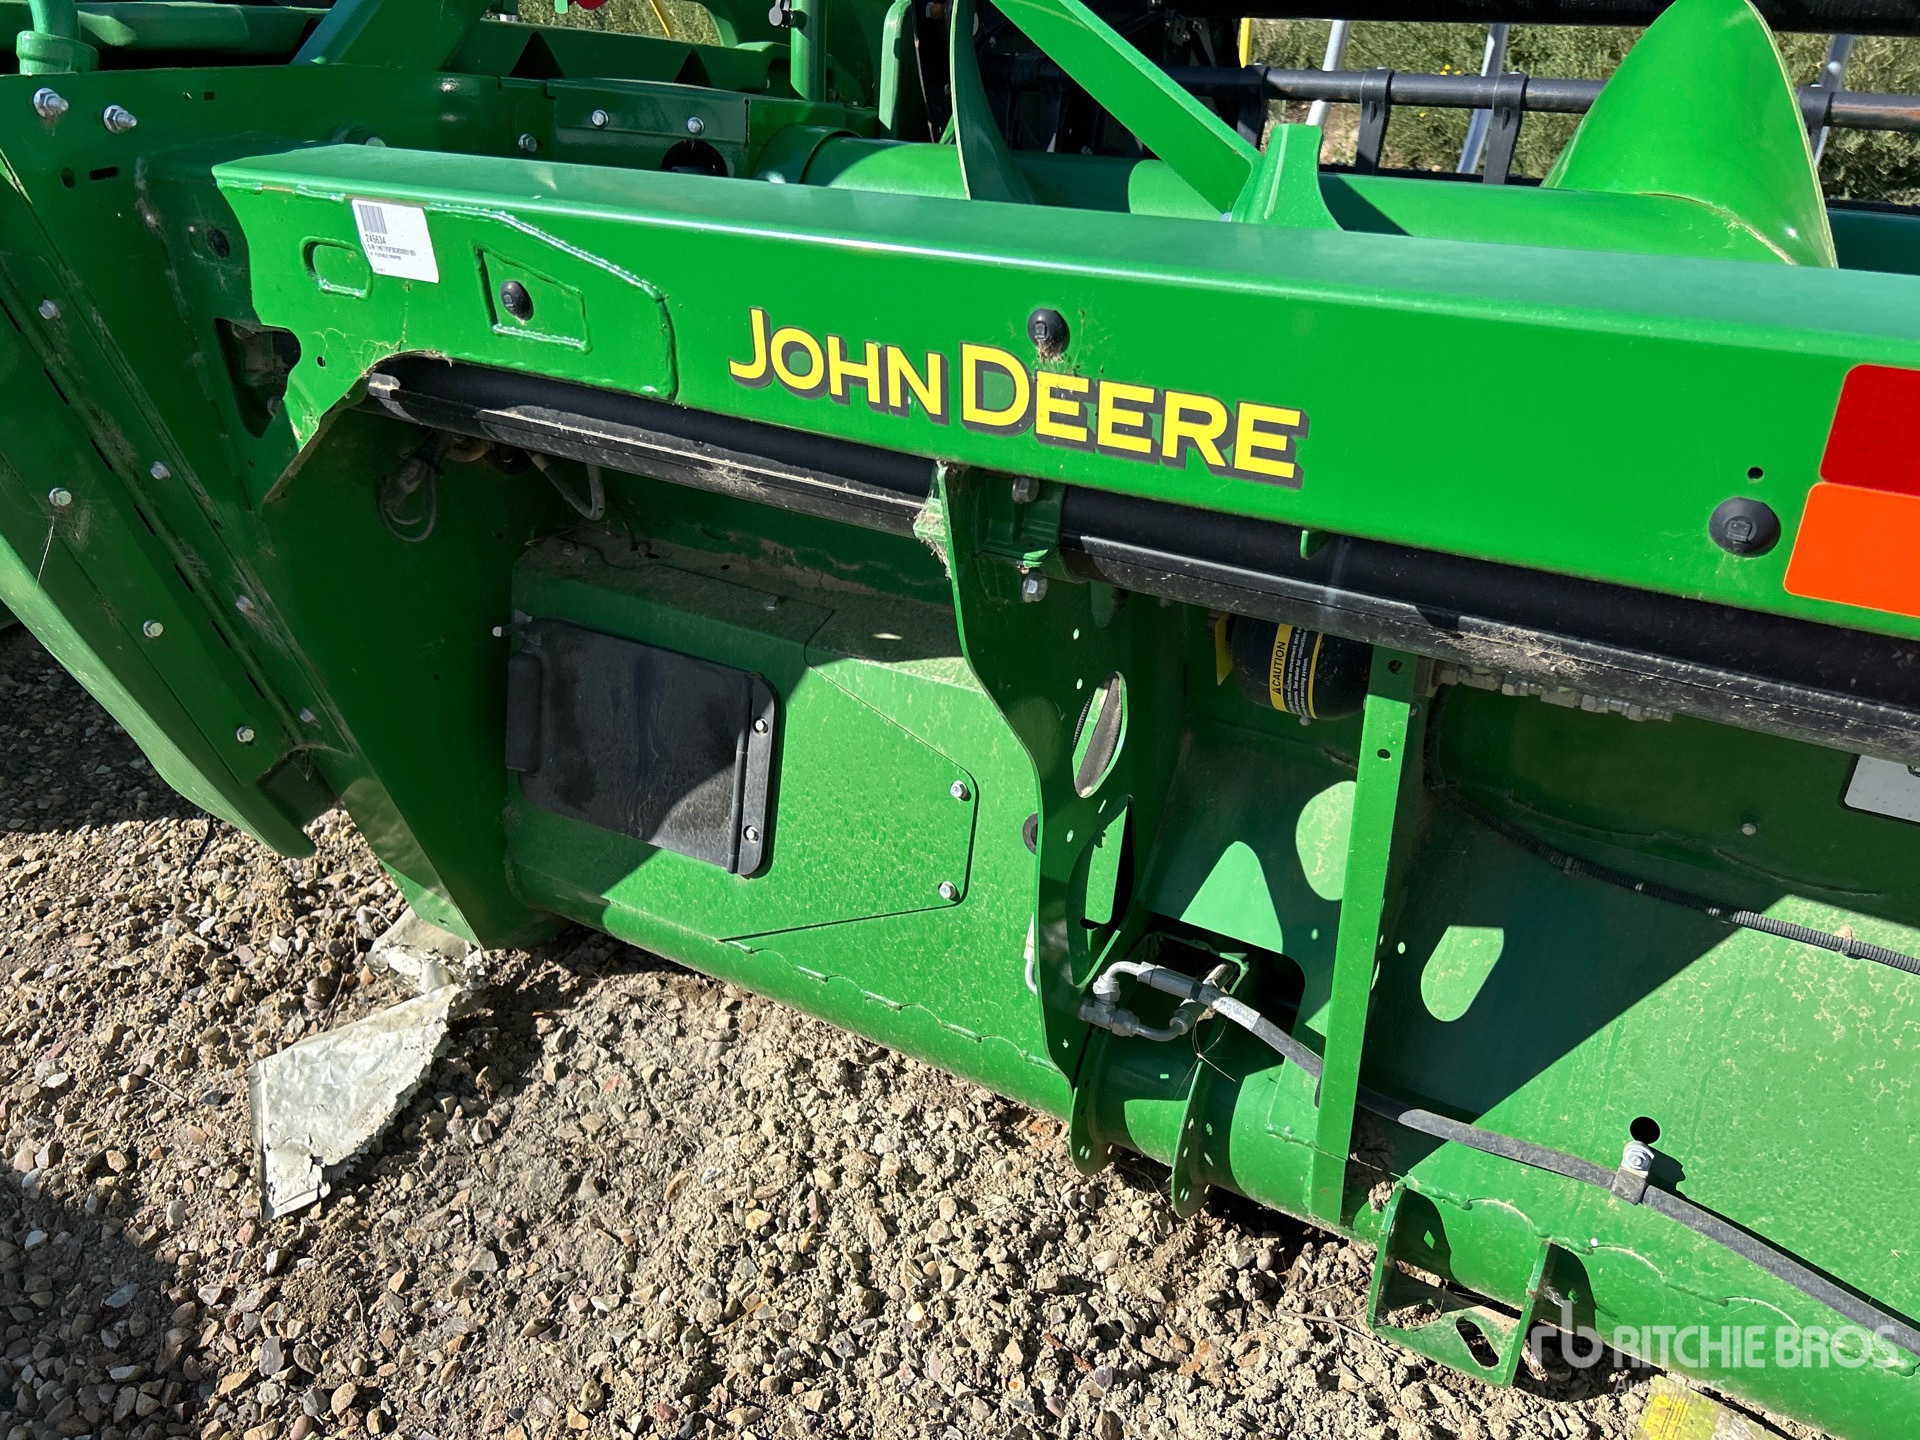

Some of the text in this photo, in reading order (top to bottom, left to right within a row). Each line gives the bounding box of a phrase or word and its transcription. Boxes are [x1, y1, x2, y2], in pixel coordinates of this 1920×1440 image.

[729, 308, 1309, 490] JOHN DEERE
[1272, 641, 1286, 687] CAUTION
[1289, 645, 1297, 672] movement
